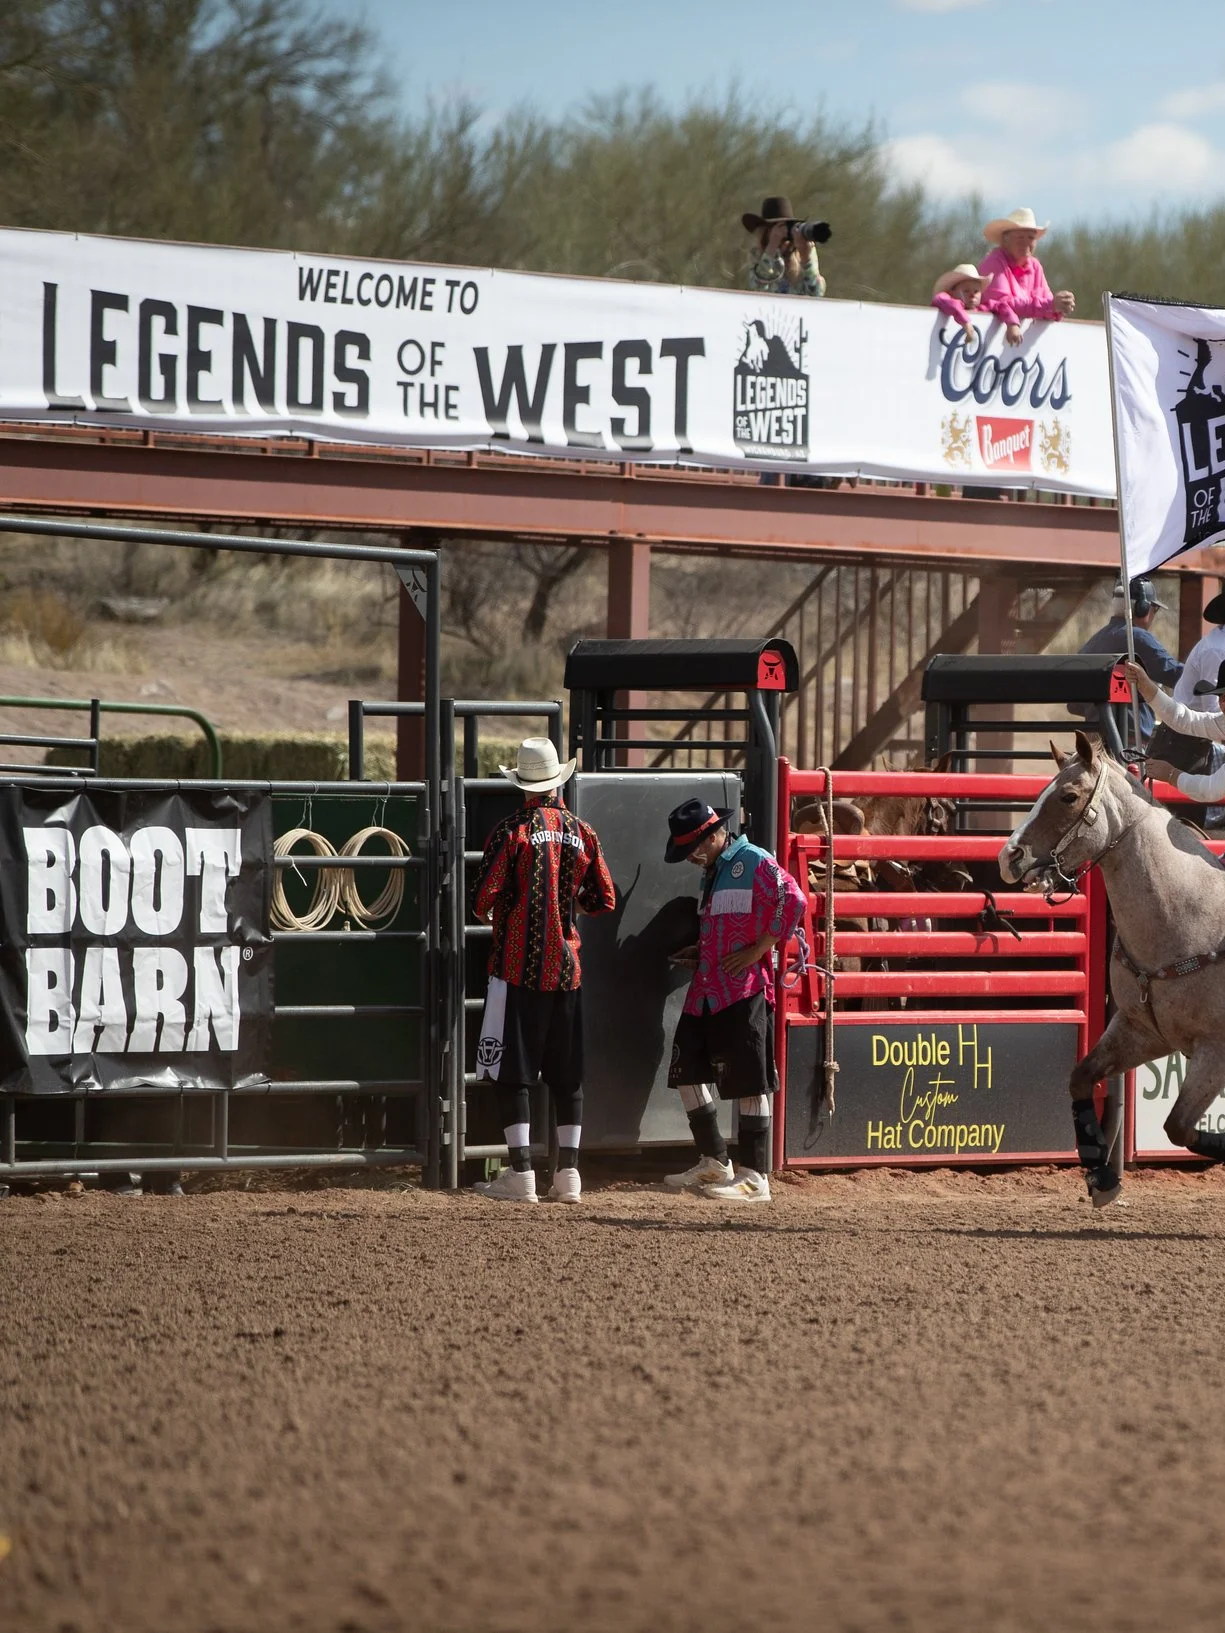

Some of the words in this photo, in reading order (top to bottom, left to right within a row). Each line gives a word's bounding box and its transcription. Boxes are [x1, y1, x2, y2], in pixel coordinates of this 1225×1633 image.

[299, 266, 436, 313] WELCOME
[445, 280, 479, 315] TO
[42, 281, 371, 419] LEGENDS
[397, 339, 445, 377] OF
[939, 324, 1072, 411] Coors
[397, 381, 460, 421] THE
[472, 337, 706, 455] WEST
[736, 374, 807, 412] LEGENDS
[735, 415, 748, 429] OF
[735, 427, 751, 440] THE
[748, 406, 807, 446] WEST
[981, 423, 1032, 466] Banquet
[1193, 486, 1216, 508] OF
[1190, 507, 1213, 529] THE
[530, 830, 585, 853] ROBINSON
[22, 826, 242, 935] BOOT
[872, 1033, 950, 1066] Double
[900, 1066, 959, 1124] Custom
[867, 1120, 903, 1150] Hat
[908, 1119, 1005, 1155] Company
